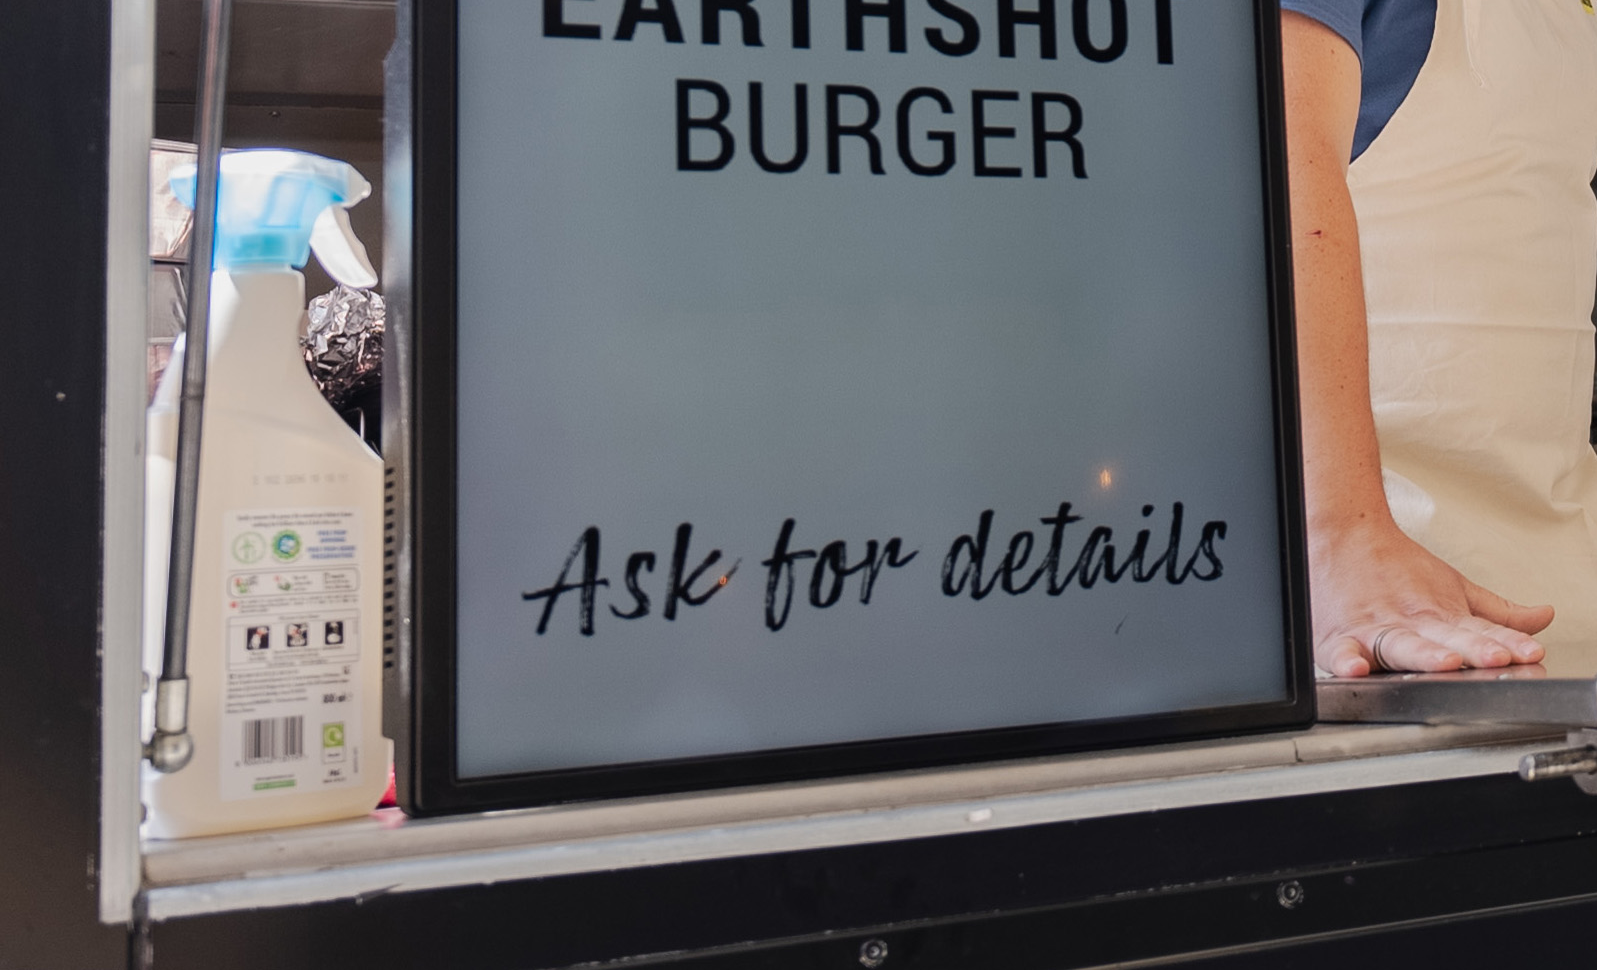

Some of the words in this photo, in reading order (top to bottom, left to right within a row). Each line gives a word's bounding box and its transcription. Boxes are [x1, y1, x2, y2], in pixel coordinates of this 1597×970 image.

[674, 77, 1090, 180] BURGER
[521, 521, 742, 637] Ask
[761, 518, 920, 632] for
[941, 501, 1228, 601] details
